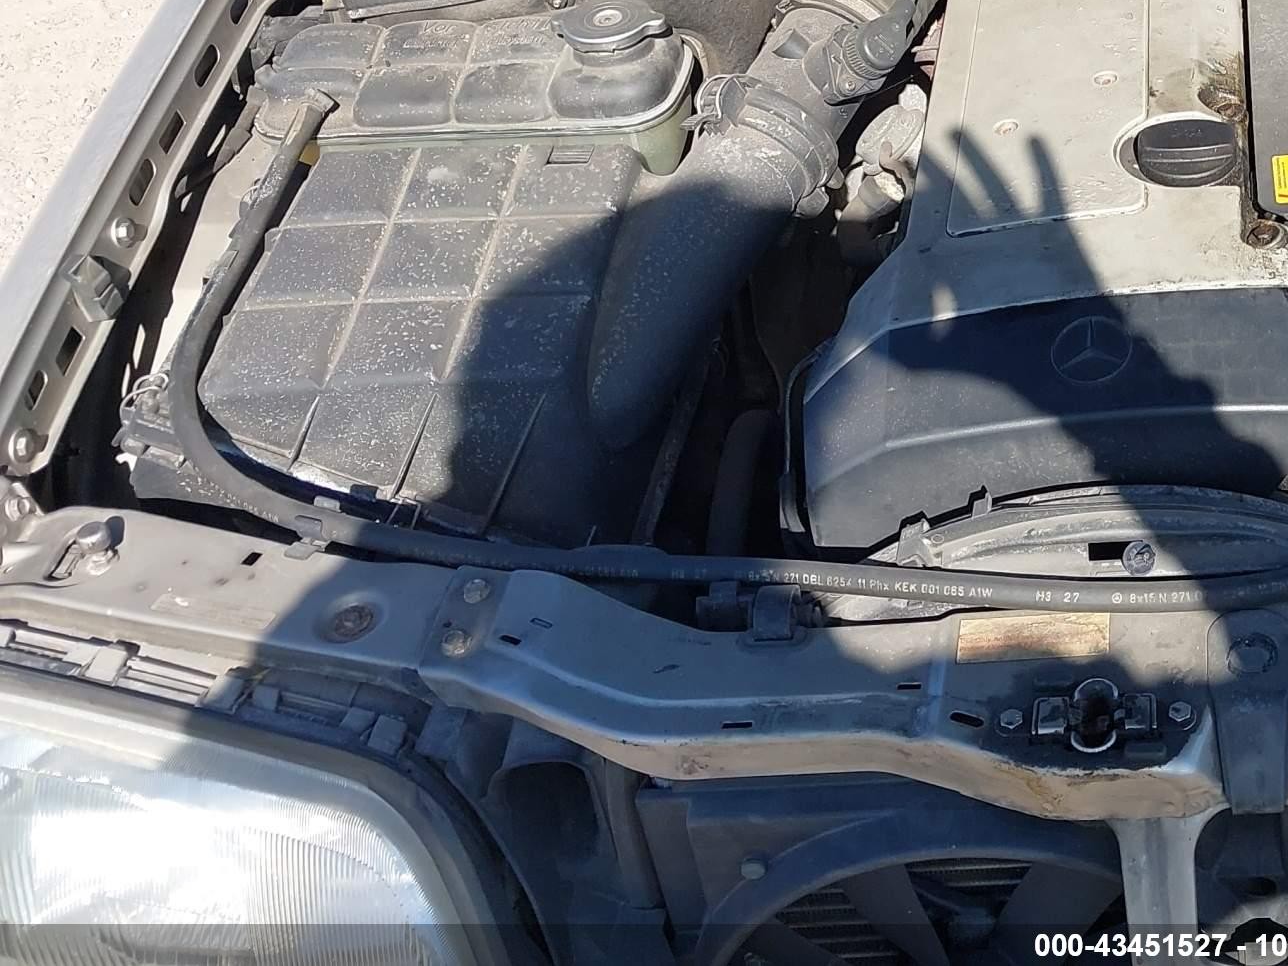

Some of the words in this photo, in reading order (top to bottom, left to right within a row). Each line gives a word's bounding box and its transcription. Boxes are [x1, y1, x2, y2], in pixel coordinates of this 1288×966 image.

[802, 574, 823, 586] DBL
[894, 581, 917, 594] KEK
[921, 583, 940, 595] 001
[1035, 590, 1052, 602] H3
[1063, 592, 1080, 603] 27
